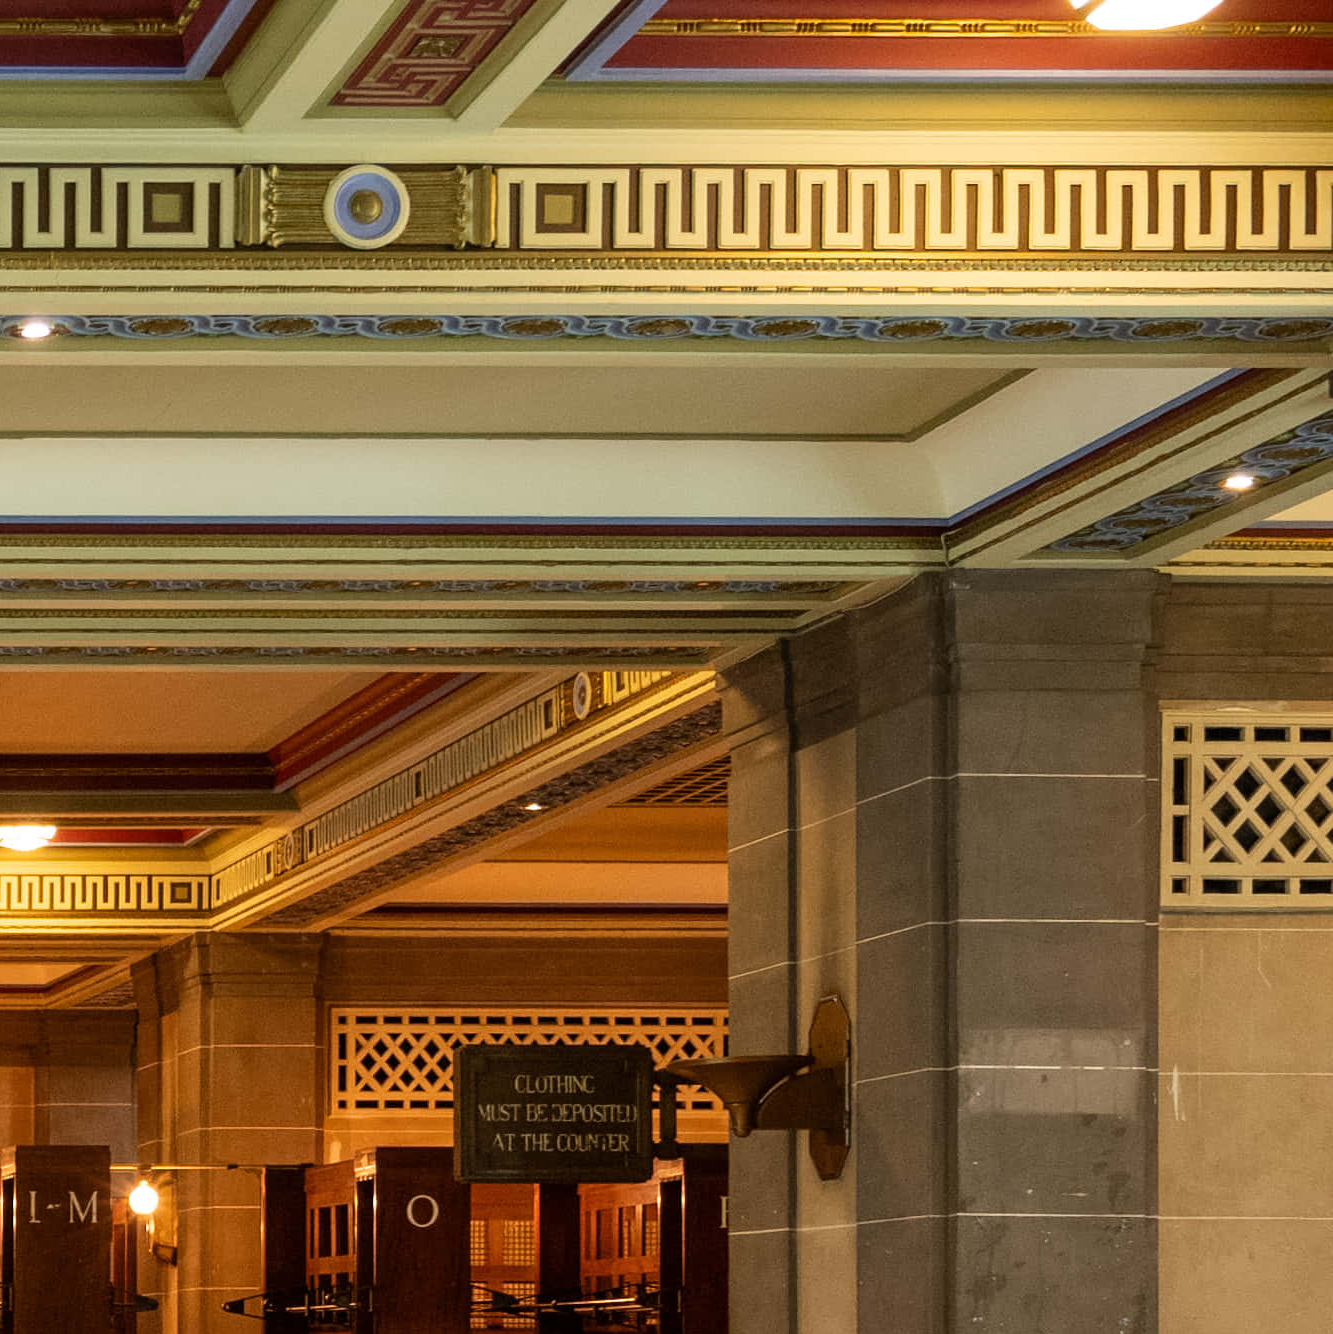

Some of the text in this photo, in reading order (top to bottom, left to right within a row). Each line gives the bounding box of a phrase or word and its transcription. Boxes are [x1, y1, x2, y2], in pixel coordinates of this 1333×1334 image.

[514, 1074, 595, 1094] CLOTHING
[478, 1103, 637, 1123] MUST BE DEPOSITED
[493, 1133, 630, 1152] AT THE COUNTER
[406, 1194, 439, 1228] O
